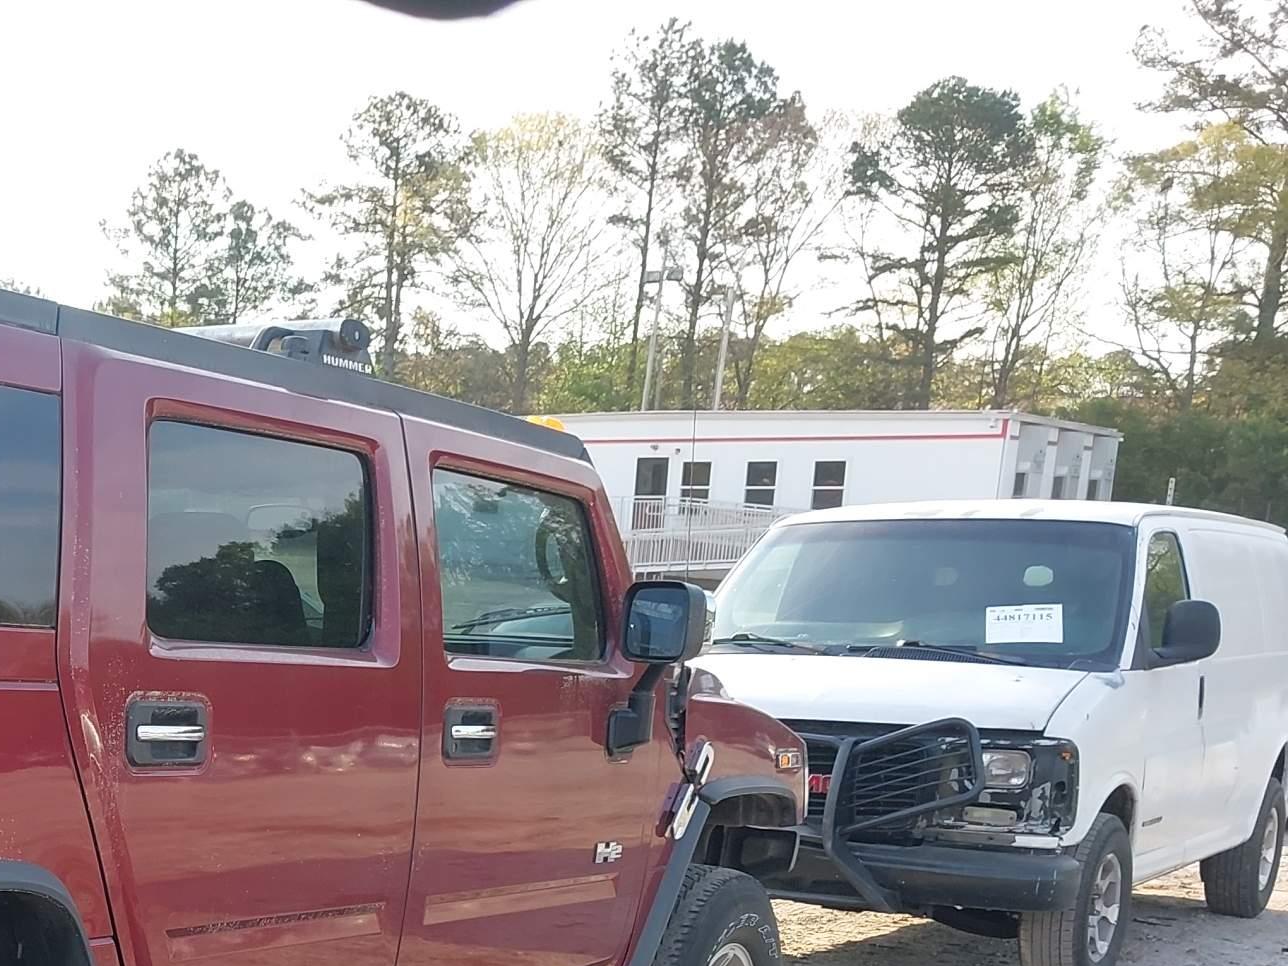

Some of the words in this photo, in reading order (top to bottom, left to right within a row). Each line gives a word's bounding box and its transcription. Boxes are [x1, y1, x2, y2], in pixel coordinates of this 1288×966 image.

[322, 354, 373, 375] HUMMER
[991, 612, 1054, 622] 44817115
[594, 841, 623, 864] H2
